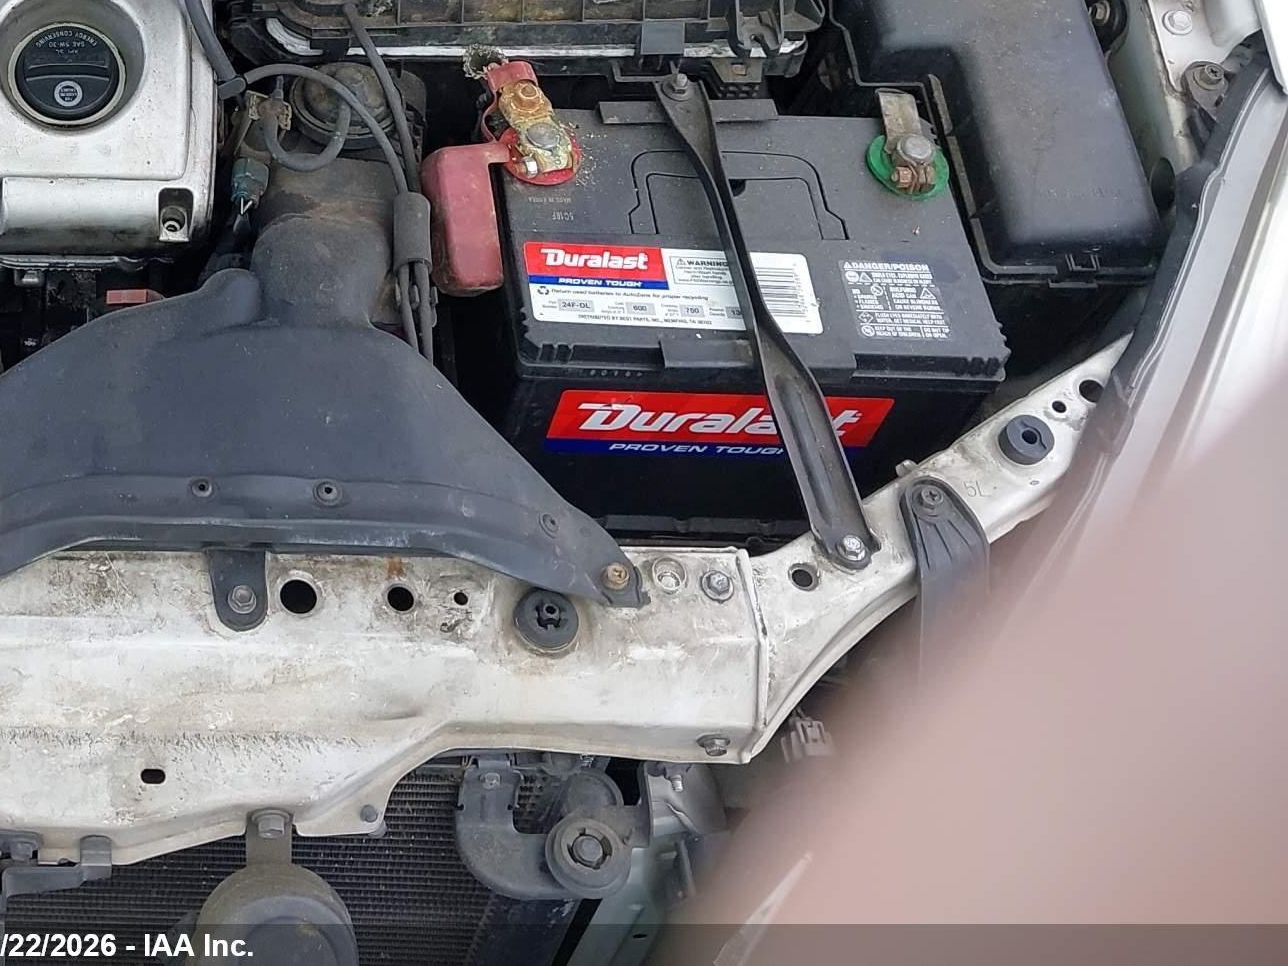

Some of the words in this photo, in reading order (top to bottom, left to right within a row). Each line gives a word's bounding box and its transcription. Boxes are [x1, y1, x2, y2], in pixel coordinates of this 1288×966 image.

[540, 248, 648, 270] Duralast
[851, 262, 930, 271] DANGER/POISON
[558, 277, 602, 286] PROVEN
[561, 301, 591, 309] 24F-DL
[578, 402, 863, 436] Duralat
[609, 443, 707, 454] PROVEN
